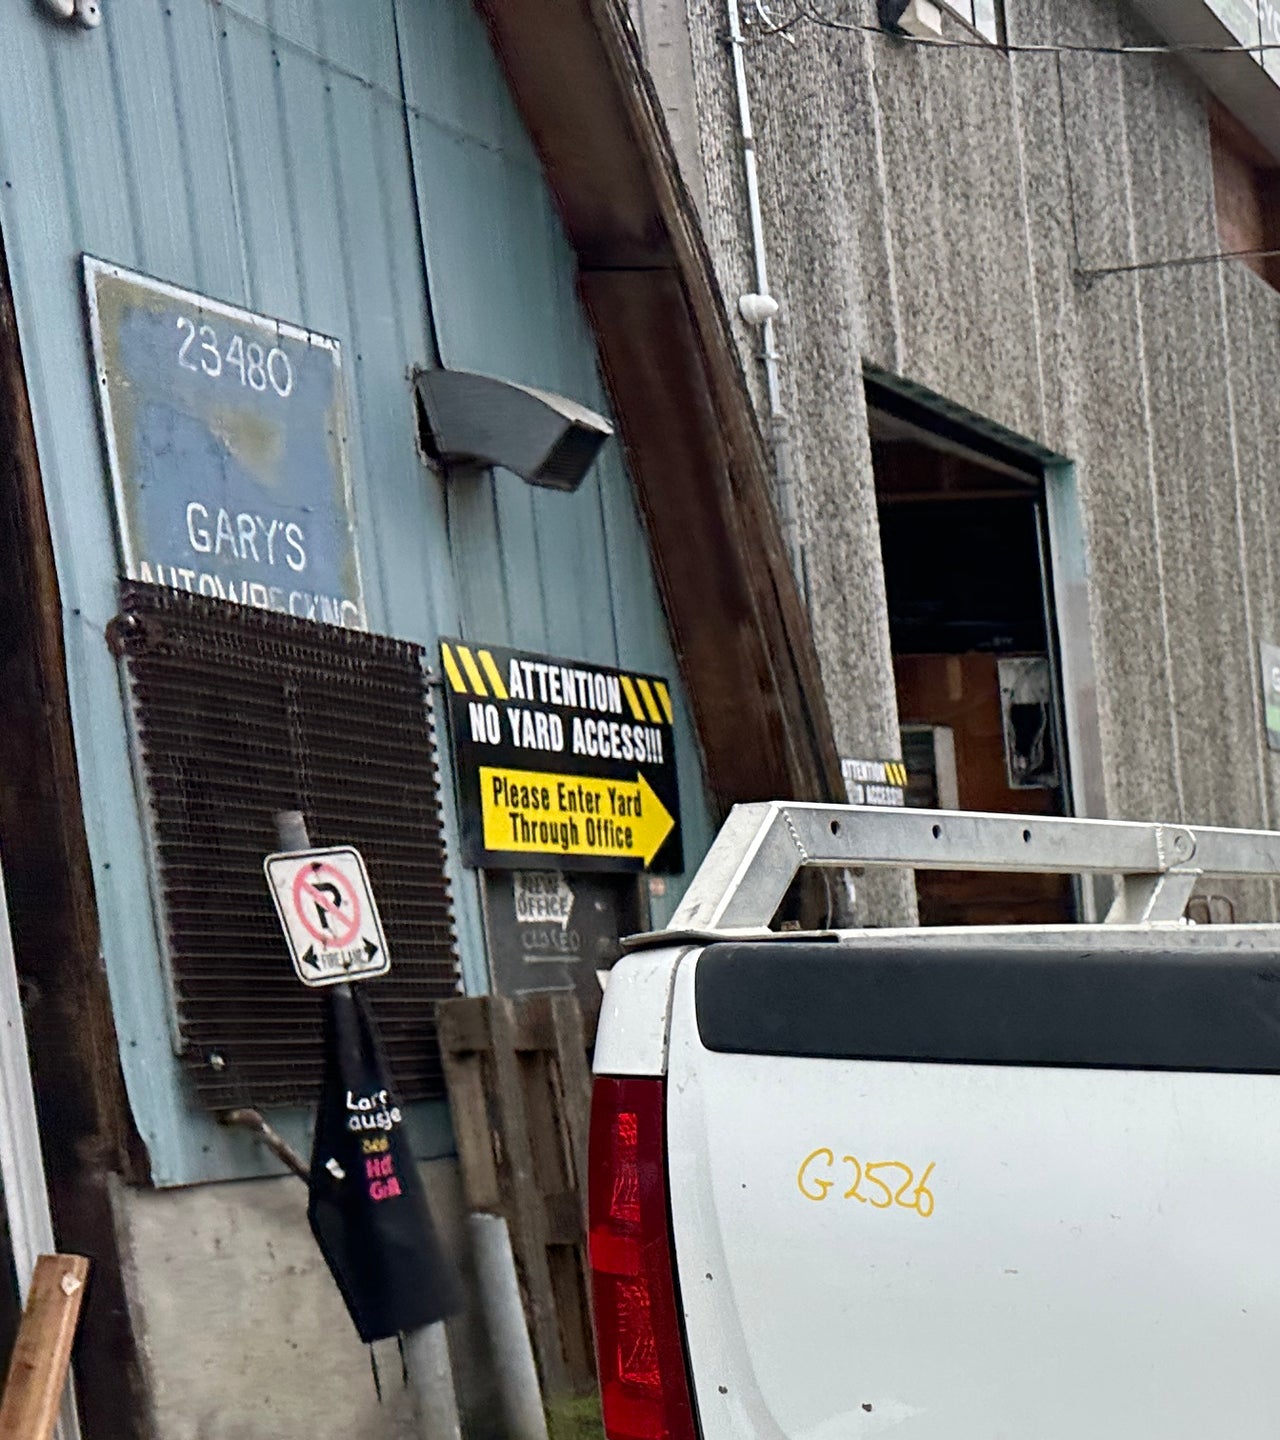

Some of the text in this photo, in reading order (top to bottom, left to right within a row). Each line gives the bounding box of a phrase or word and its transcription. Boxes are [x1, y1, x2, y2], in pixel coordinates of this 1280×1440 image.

[177, 316, 293, 397] 23480
[186, 501, 306, 572] GARY'S
[509, 658, 624, 715] ATTENTION
[468, 701, 665, 765] NO YARD ACCESS!!!
[491, 775, 643, 818] Please Enter Yard
[508, 811, 634, 850] Through Office
[517, 892, 569, 917] OFFICE
[797, 1147, 937, 1218] G2526
